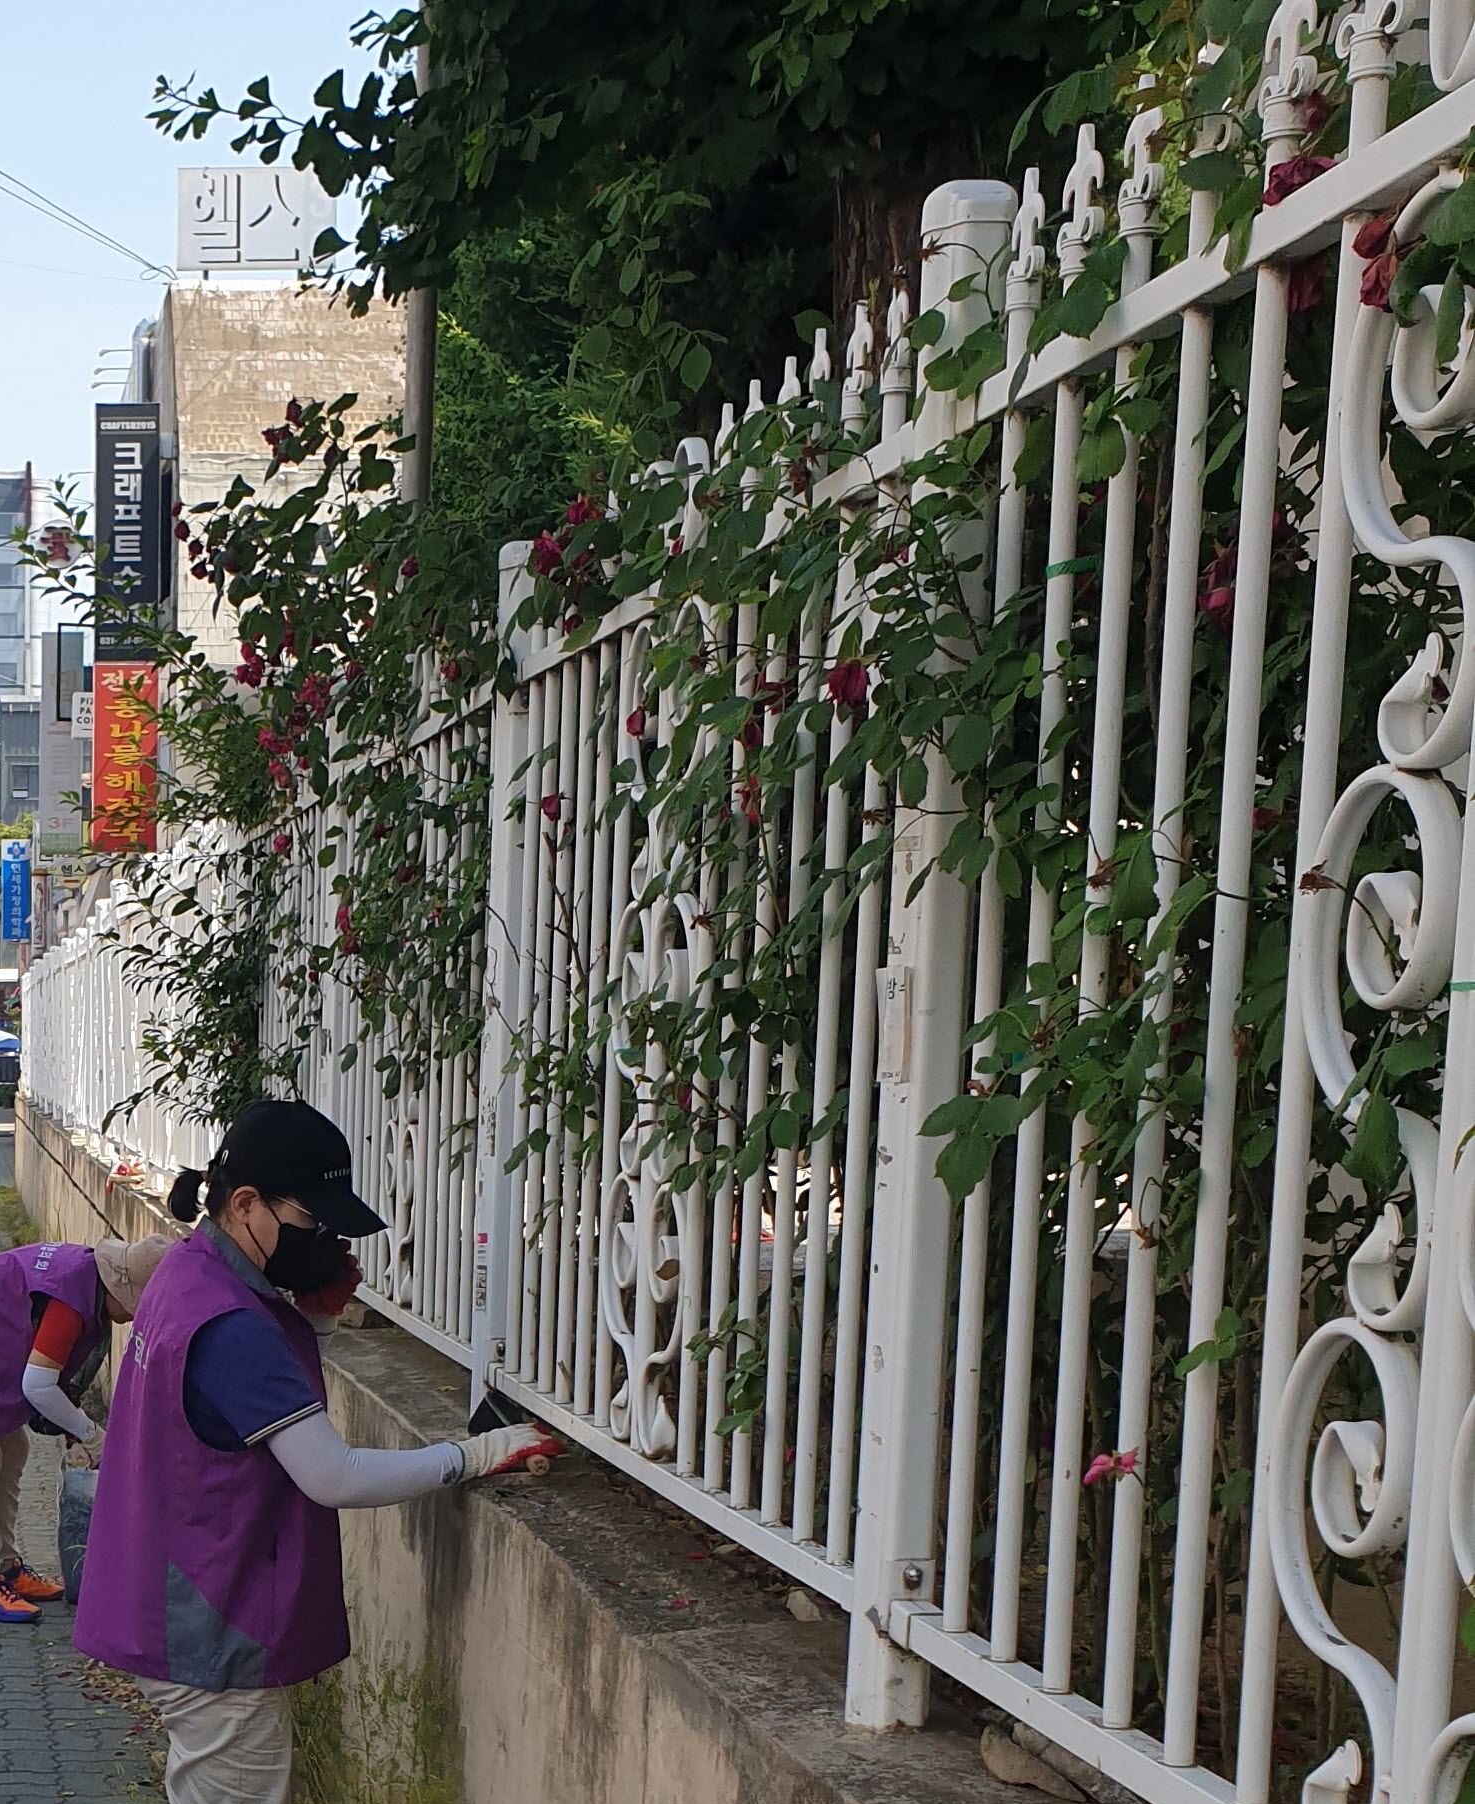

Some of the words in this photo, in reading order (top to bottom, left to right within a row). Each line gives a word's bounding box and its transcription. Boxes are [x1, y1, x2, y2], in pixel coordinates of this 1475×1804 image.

[113, 442, 143, 594] 크래프트수
[101, 670, 153, 692] 전주
[48, 817, 74, 829] 3F
